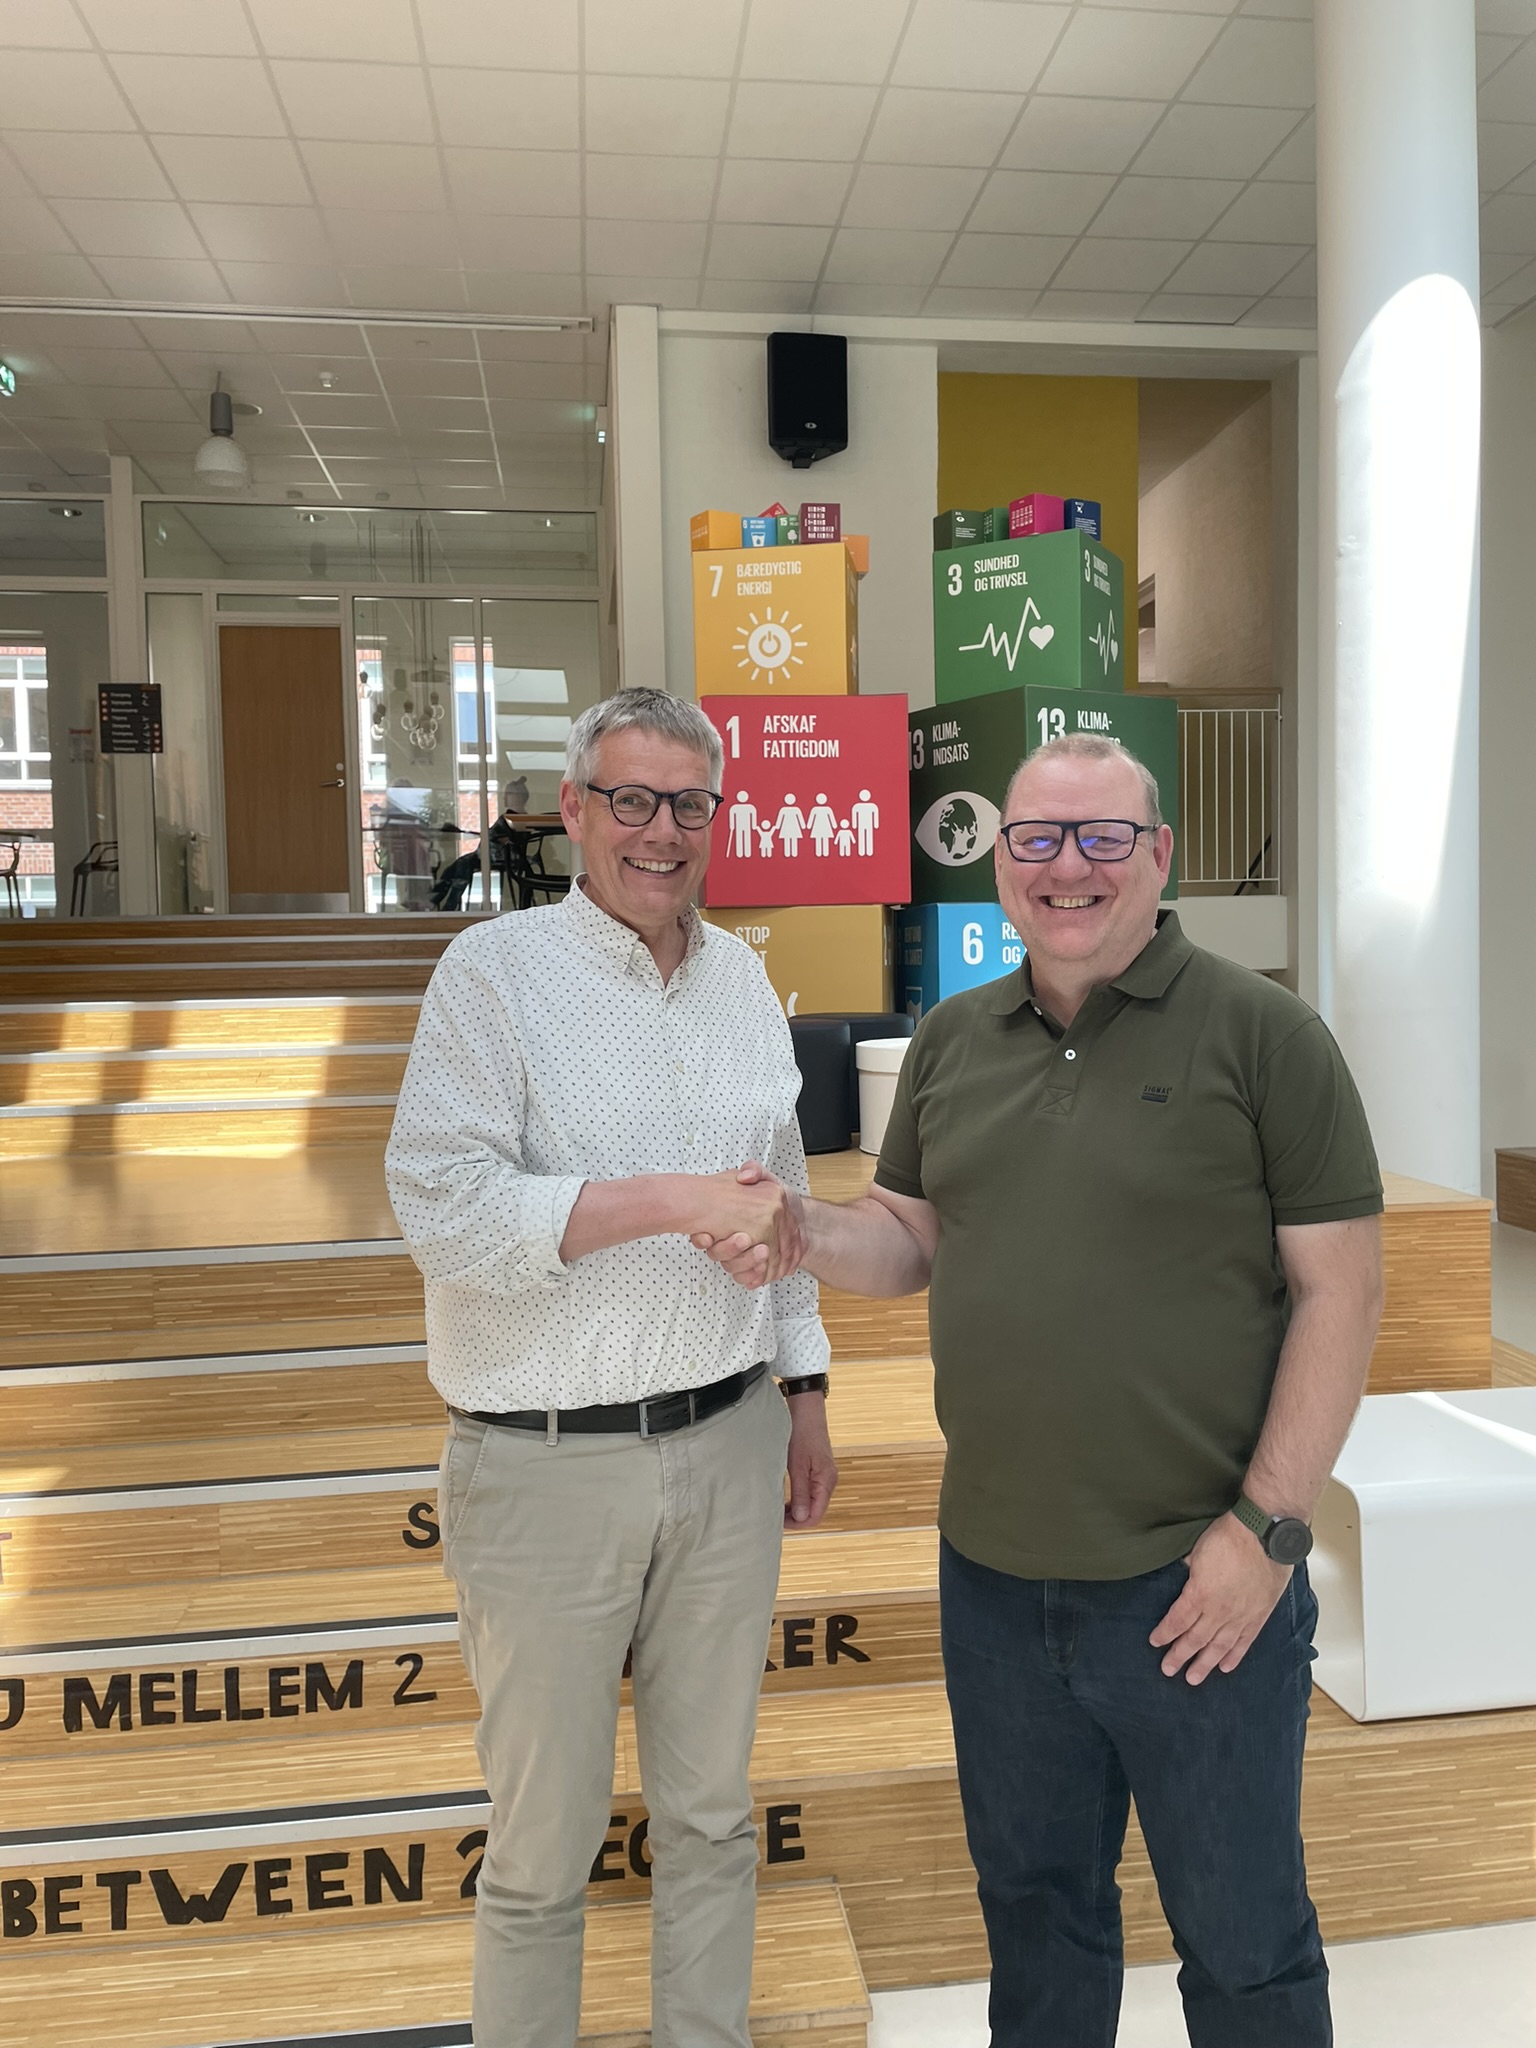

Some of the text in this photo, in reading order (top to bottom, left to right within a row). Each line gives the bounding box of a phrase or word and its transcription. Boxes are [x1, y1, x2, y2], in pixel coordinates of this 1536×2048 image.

[736, 561, 802, 578] BÆREDYGTIG
[974, 554, 1020, 574] SUNDHED
[1084, 549, 1091, 582] 3
[709, 565, 723, 597] 7
[737, 581, 772, 596] ENERGI
[948, 563, 963, 596] 3
[974, 571, 1028, 592] OG TRIVSEL
[763, 715, 817, 733] AFSKAF
[1037, 707, 1066, 746] 13
[1077, 710, 1112, 731] KLIMA-
[726, 715, 740, 758] 1
[932, 721, 961, 742] KLIMA-
[763, 739, 839, 758] FATTIGDOM
[933, 742, 969, 766] INDSATS
[735, 926, 770, 944] STOP
[1002, 922, 1022, 940] RE
[962, 922, 984, 965] 6
[1002, 946, 1020, 964] OG
[63, 1660, 364, 1732] MELLEM
[393, 1653, 437, 1706] 2
[1, 1843, 425, 1938] BETWEEN
